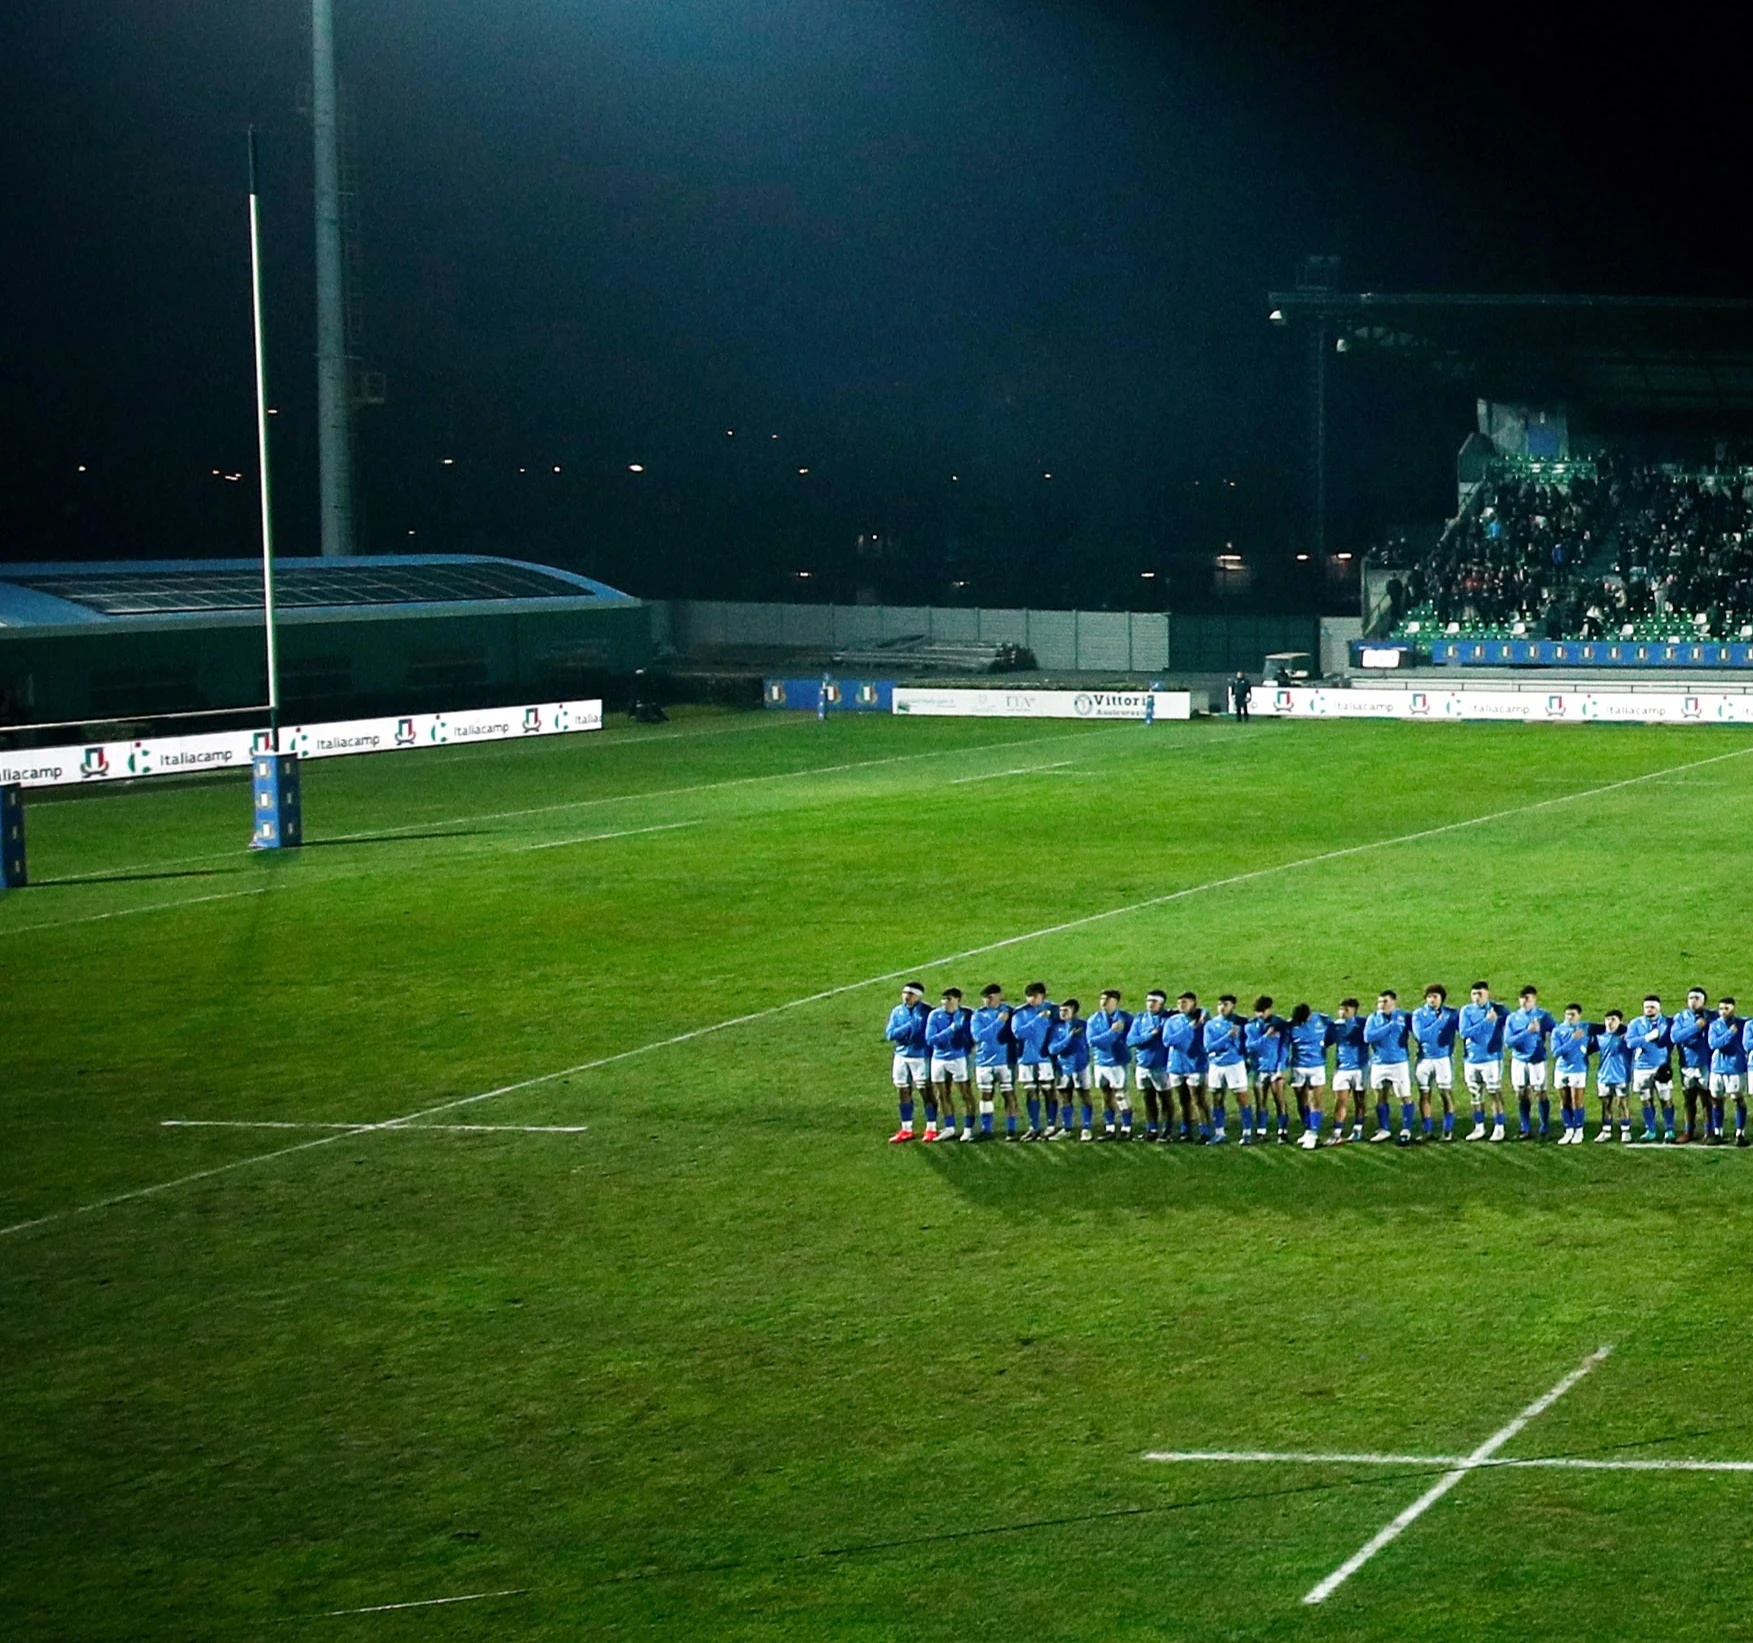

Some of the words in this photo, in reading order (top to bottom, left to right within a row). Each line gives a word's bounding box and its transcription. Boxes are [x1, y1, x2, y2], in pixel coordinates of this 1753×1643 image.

[1094, 695, 1147, 706] Vittori
[1334, 702, 1394, 713] Italiacamp
[1470, 705, 1530, 715] Italiacamp
[1606, 706, 1666, 716] Italiacamp
[454, 723, 509, 736] Italiacamp
[317, 734, 380, 750] Italiacamp
[160, 749, 233, 766] Italiacamp
